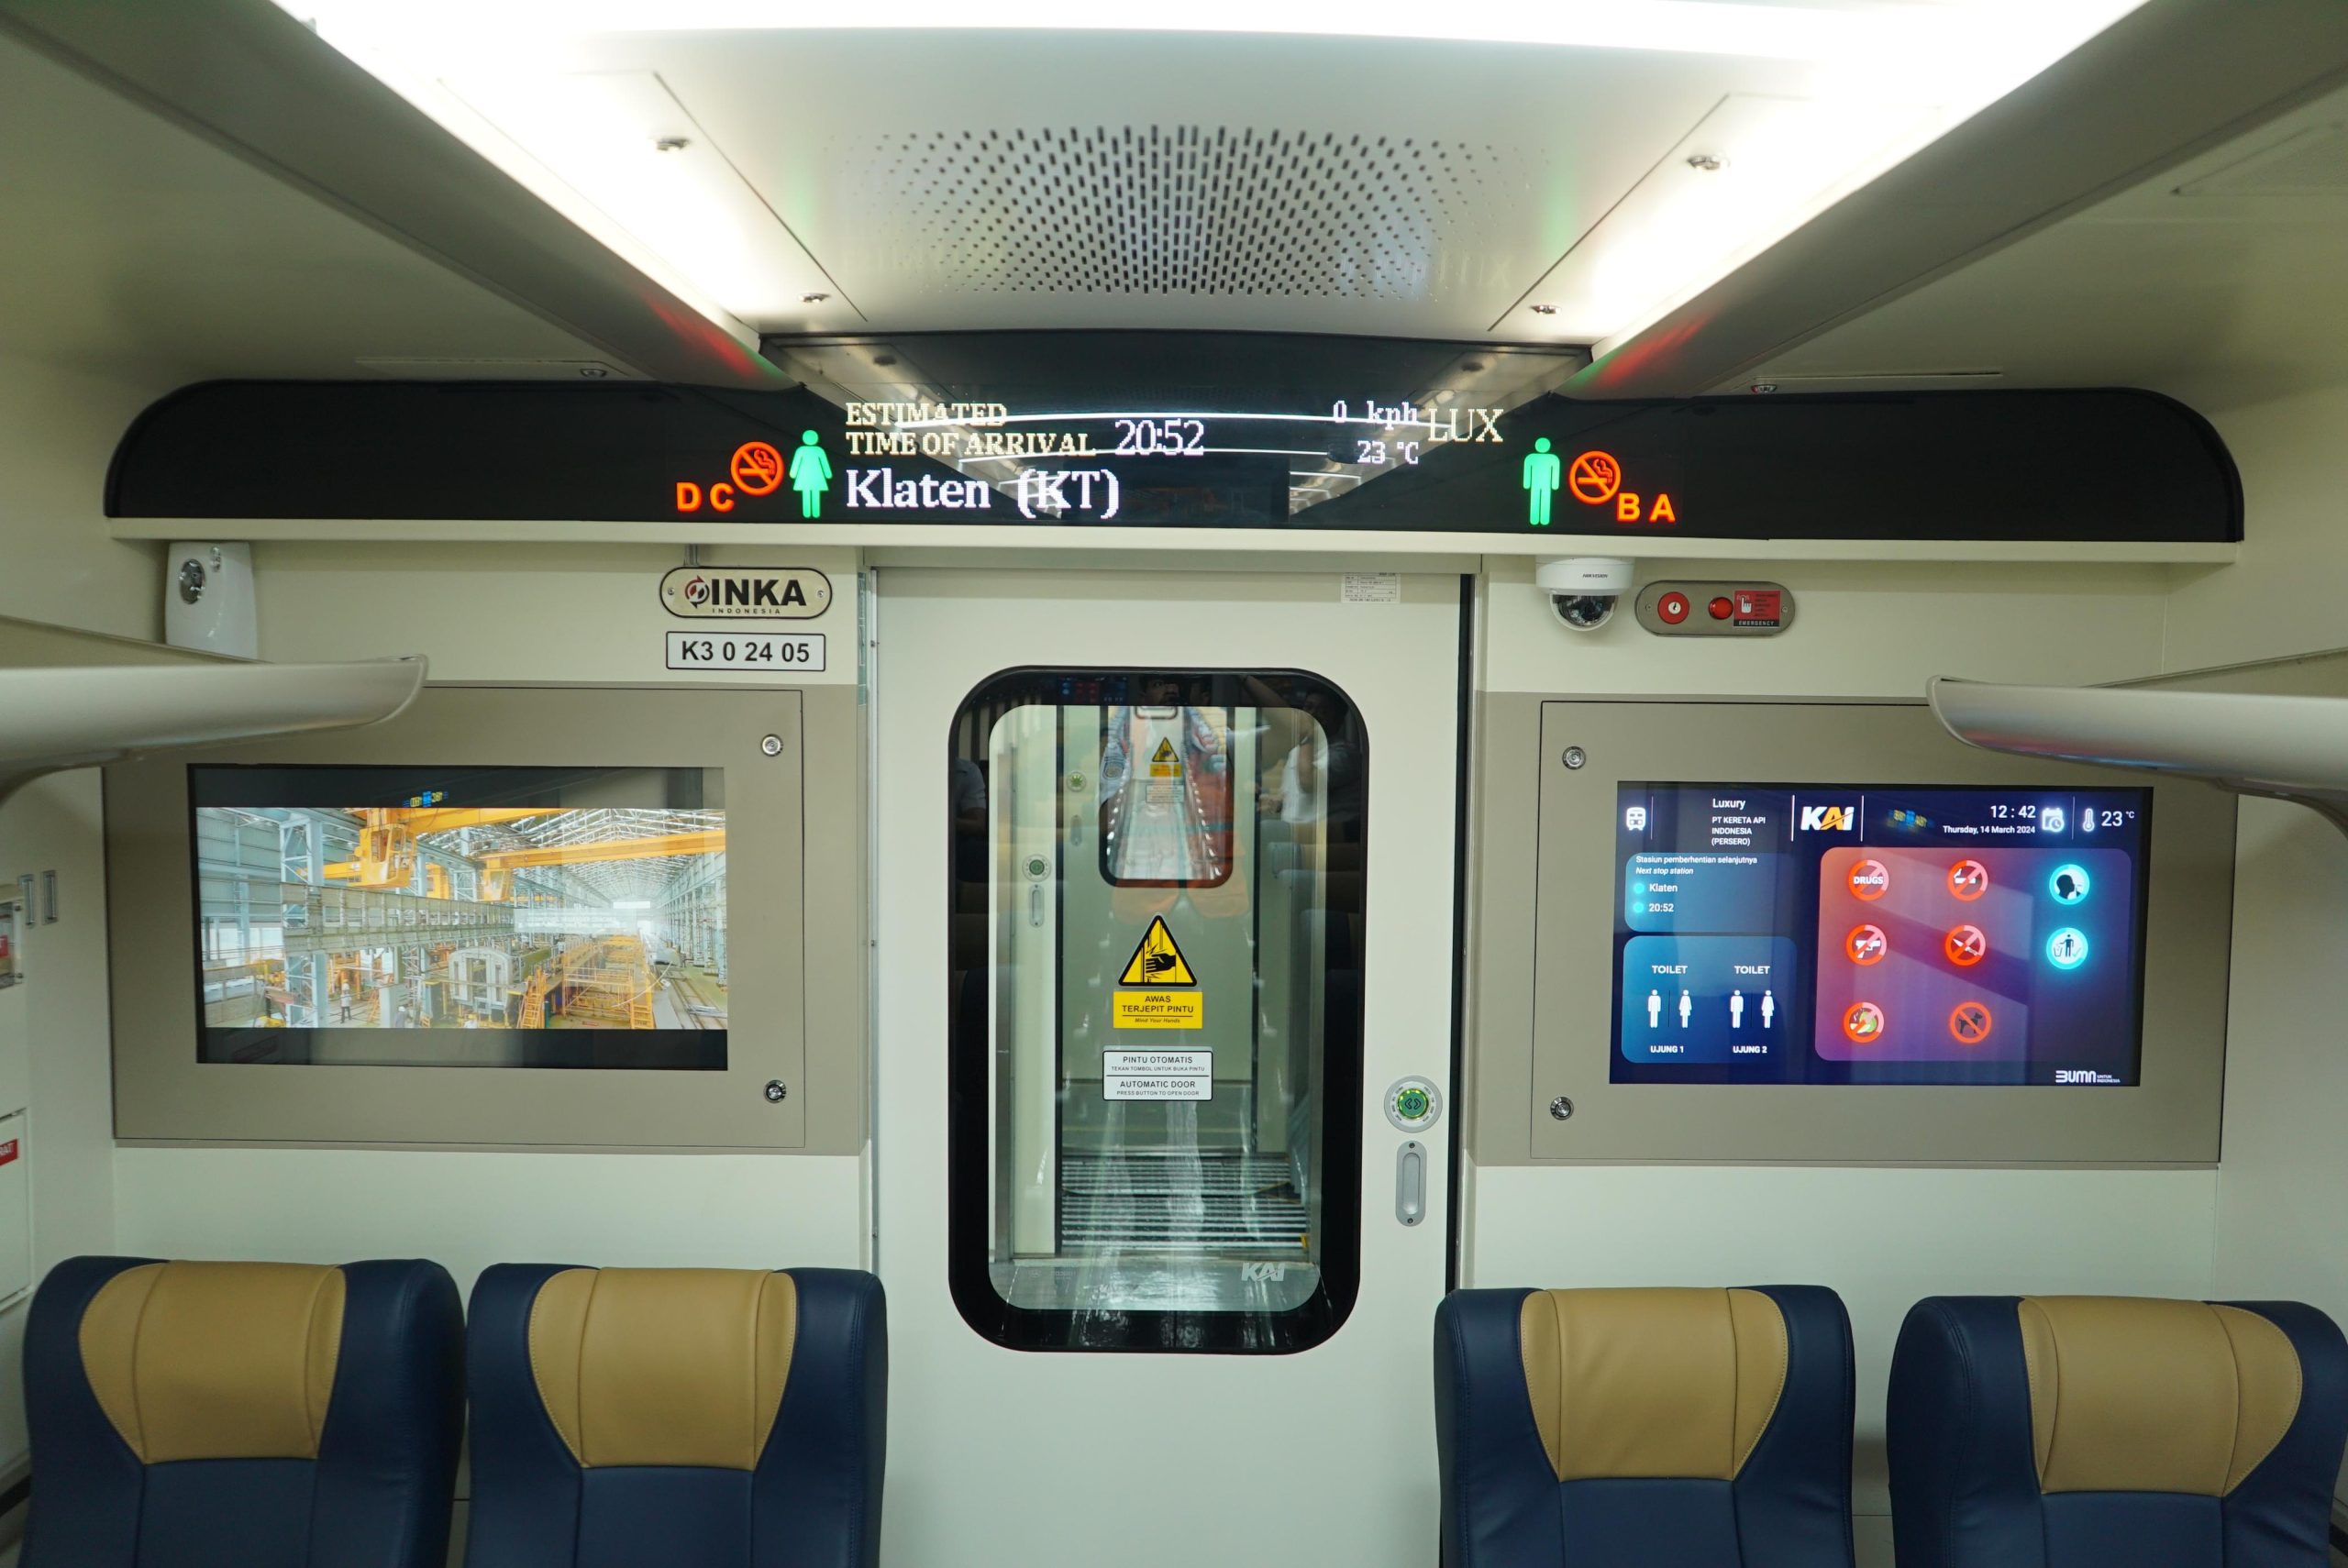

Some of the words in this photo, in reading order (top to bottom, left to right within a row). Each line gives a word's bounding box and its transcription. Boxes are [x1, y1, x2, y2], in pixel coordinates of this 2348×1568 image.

[846, 403, 1007, 426] ESTIMATED
[1333, 400, 1347, 423] 0
[1367, 400, 1419, 431] kph
[1428, 408, 1504, 443] LUX
[1115, 418, 1204, 456] 20:52
[846, 432, 916, 456] TIME
[922, 432, 959, 456] OF
[964, 433, 1097, 457] ARRIVAL
[1357, 440, 1386, 465] 23
[676, 481, 702, 513] D
[710, 482, 734, 513] C
[846, 468, 991, 509] Klaten
[1017, 469, 1120, 520] (KT)
[1617, 494, 1640, 522] B
[1649, 494, 1676, 523] A
[711, 579, 807, 606] INKA
[681, 640, 714, 661] K3
[744, 642, 772, 662] 24
[781, 643, 810, 663] 05
[1712, 798, 1746, 811] Luxury
[1711, 816, 1722, 824] PT
[1723, 816, 1752, 824] KERETA
[1753, 816, 1766, 824] API
[1800, 806, 1855, 831] KAI
[2101, 811, 2123, 827] 23
[1711, 827, 1753, 835] INDONESIA
[1943, 825, 1978, 834] Thursday,
[1980, 825, 1989, 834] 14
[1991, 825, 2015, 834] March
[2017, 825, 2035, 834] 2024
[1711, 837, 1751, 846] (PERSERO)
[1635, 856, 1663, 864] Stasiun
[1664, 856, 1716, 865] pemberhentian
[1717, 856, 1758, 865] selanjutnya
[1635, 867, 1652, 875] Next
[1653, 867, 1668, 876] stop
[1853, 876, 1884, 885] DRUGS
[1649, 883, 1678, 892] Klaten
[1648, 903, 1675, 912] 20:52
[1652, 965, 1688, 975] TOILET
[1733, 966, 1770, 975] TOILET
[1145, 995, 1171, 1003] AWAS
[1167, 1005, 1194, 1013] PINTU
[1650, 1045, 1677, 1054] UJUNG
[1733, 1045, 1759, 1054] UJUNG
[2055, 1070, 2097, 1083] BUMN
[1120, 1080, 1168, 1088] AUTOMATIC
[1241, 1262, 1285, 1282] KAI
